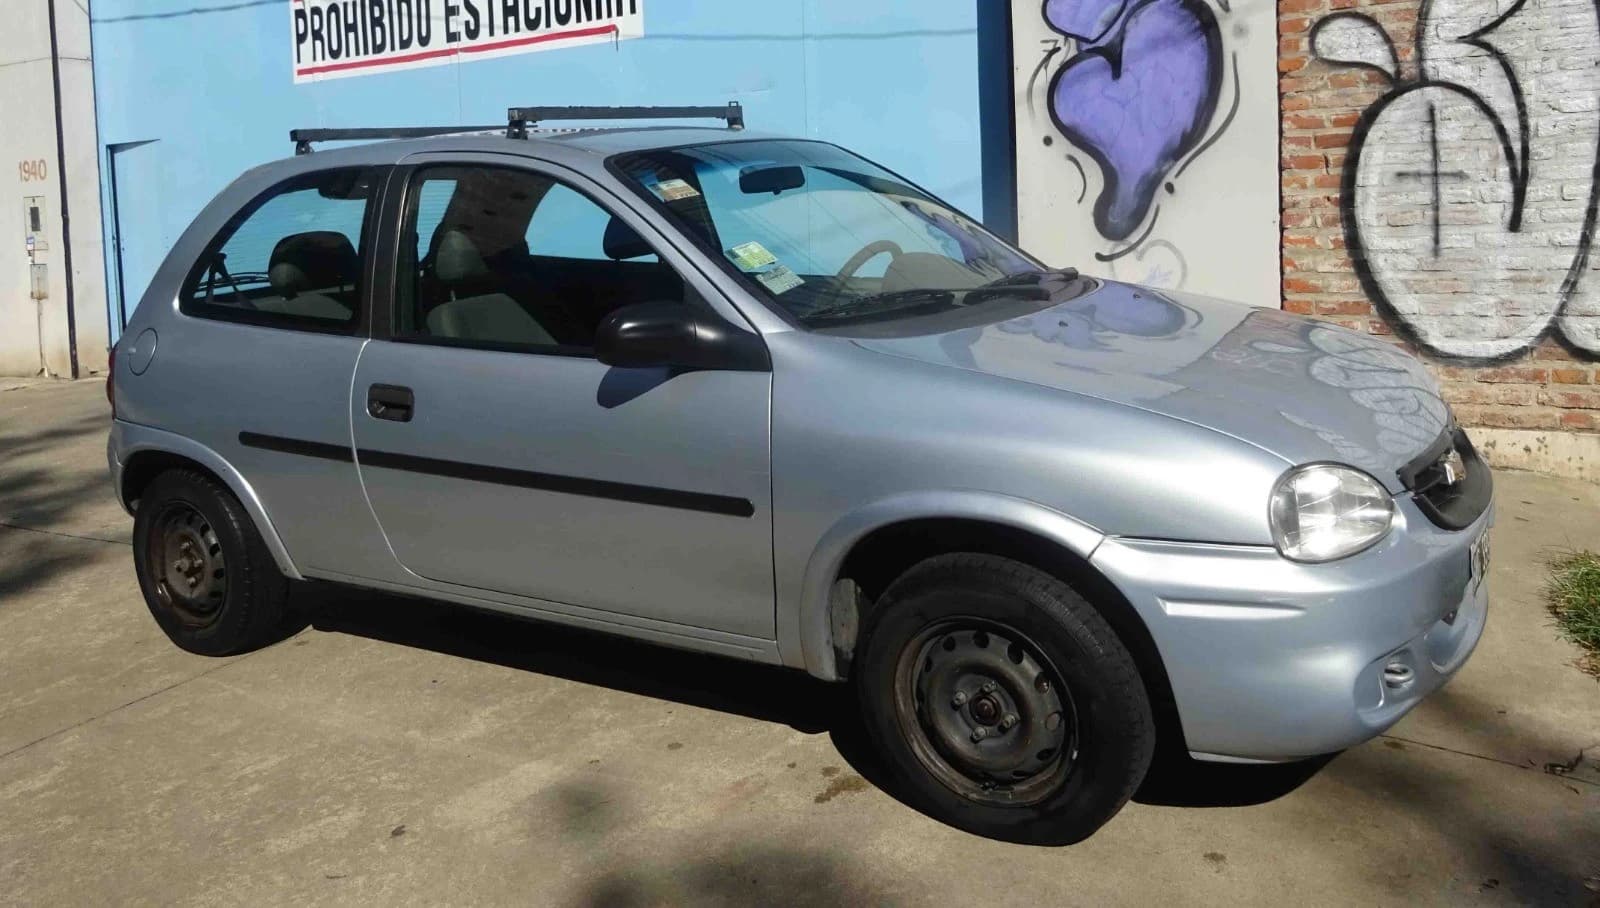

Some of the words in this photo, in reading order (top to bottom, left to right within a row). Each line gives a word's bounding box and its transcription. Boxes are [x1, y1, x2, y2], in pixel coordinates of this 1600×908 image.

[294, 0, 431, 64] PROHIBIDO
[444, 0, 637, 43] ESTACI
[18, 159, 47, 183] 1940
